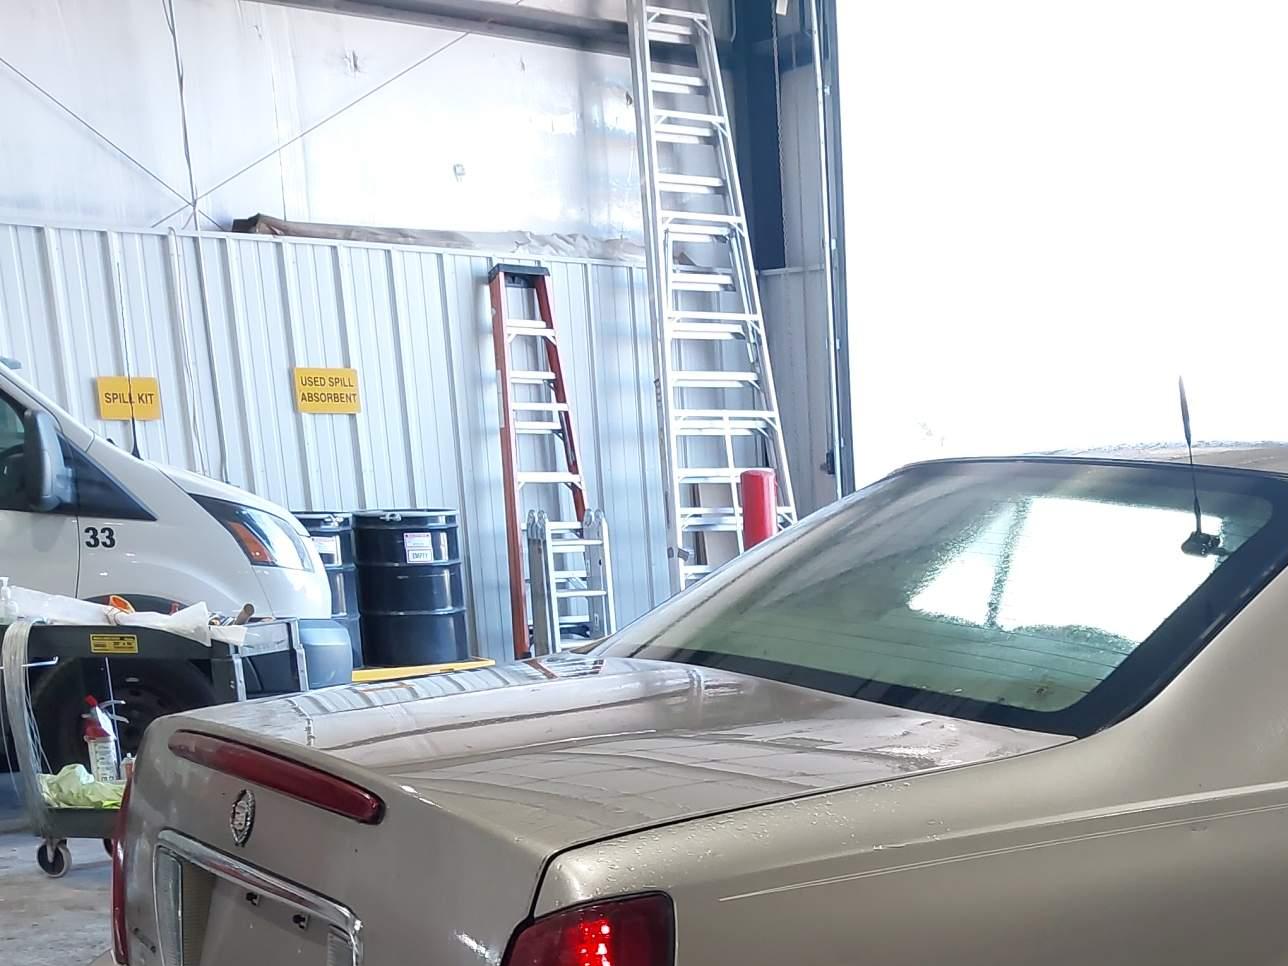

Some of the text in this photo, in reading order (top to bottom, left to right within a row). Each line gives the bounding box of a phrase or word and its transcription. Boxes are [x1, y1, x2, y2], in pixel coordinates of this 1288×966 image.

[300, 375, 354, 388] USED SPILL
[104, 392, 155, 405] SPILL KIT
[301, 391, 357, 404] ABSORBENT
[84, 526, 116, 549] 33
